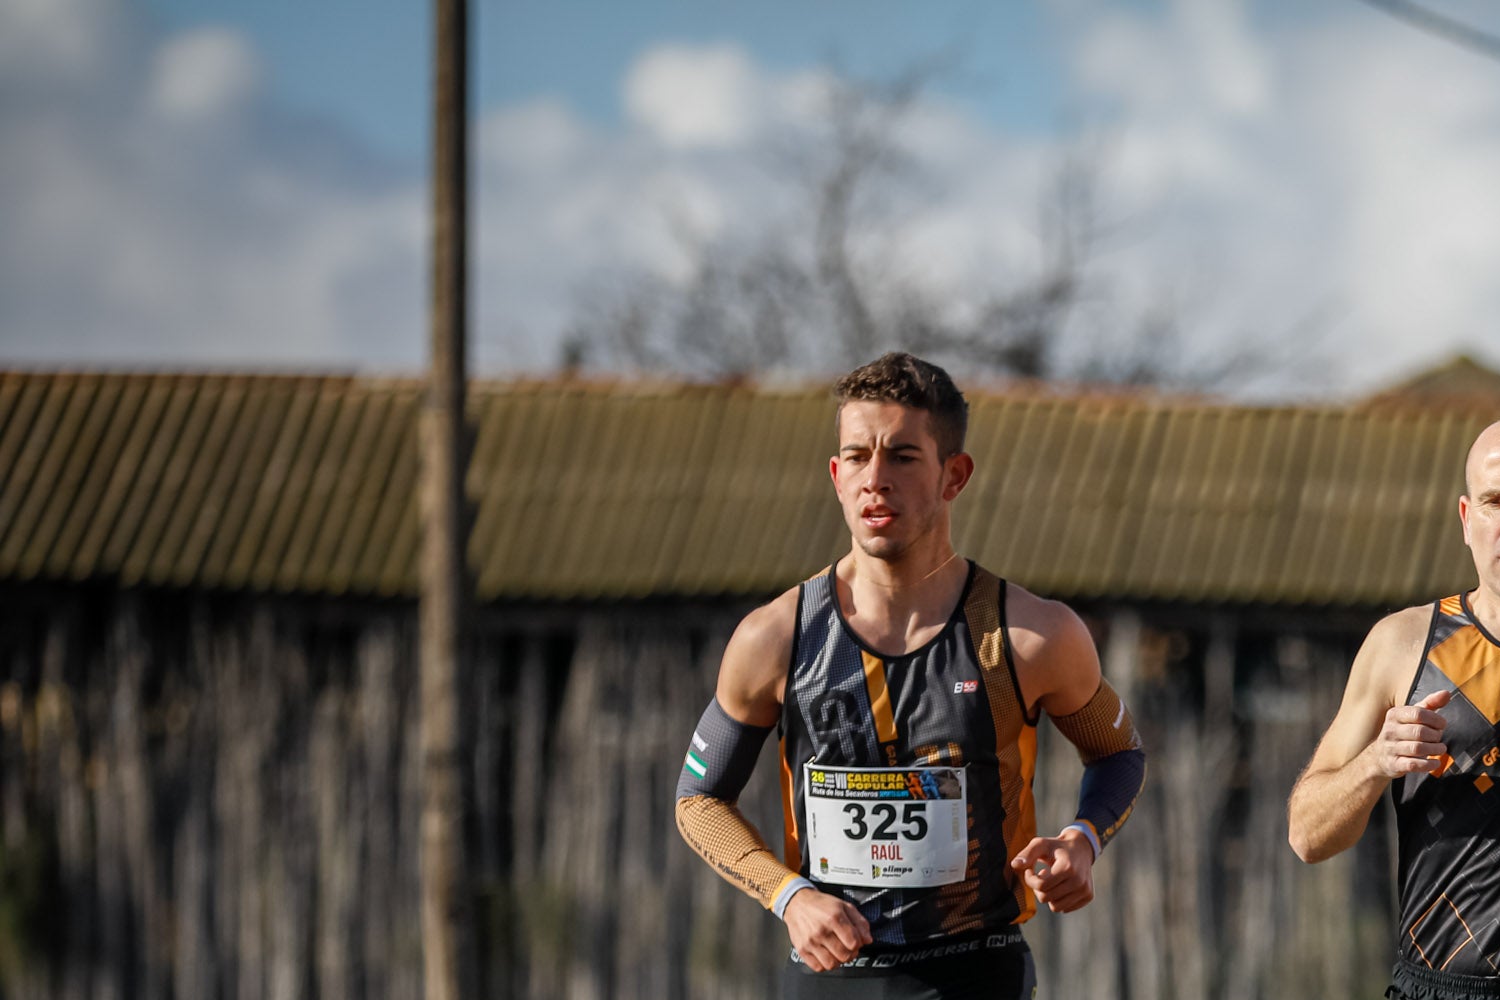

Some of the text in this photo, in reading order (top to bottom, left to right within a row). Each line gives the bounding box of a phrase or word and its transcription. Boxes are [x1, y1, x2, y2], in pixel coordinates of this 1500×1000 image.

[811, 771, 825, 783] 26
[834, 773, 848, 789] VII
[847, 773, 905, 783] CARRERA
[847, 782, 905, 790] POPULAR
[812, 786, 826, 795] Ruta
[826, 788, 834, 796] de
[834, 789, 844, 797] los
[845, 789, 878, 798] Secaderos
[842, 803, 928, 841] 325
[871, 842, 904, 861] RAÚL
[882, 865, 913, 874] olimpo
[899, 939, 980, 964] INVERSE
